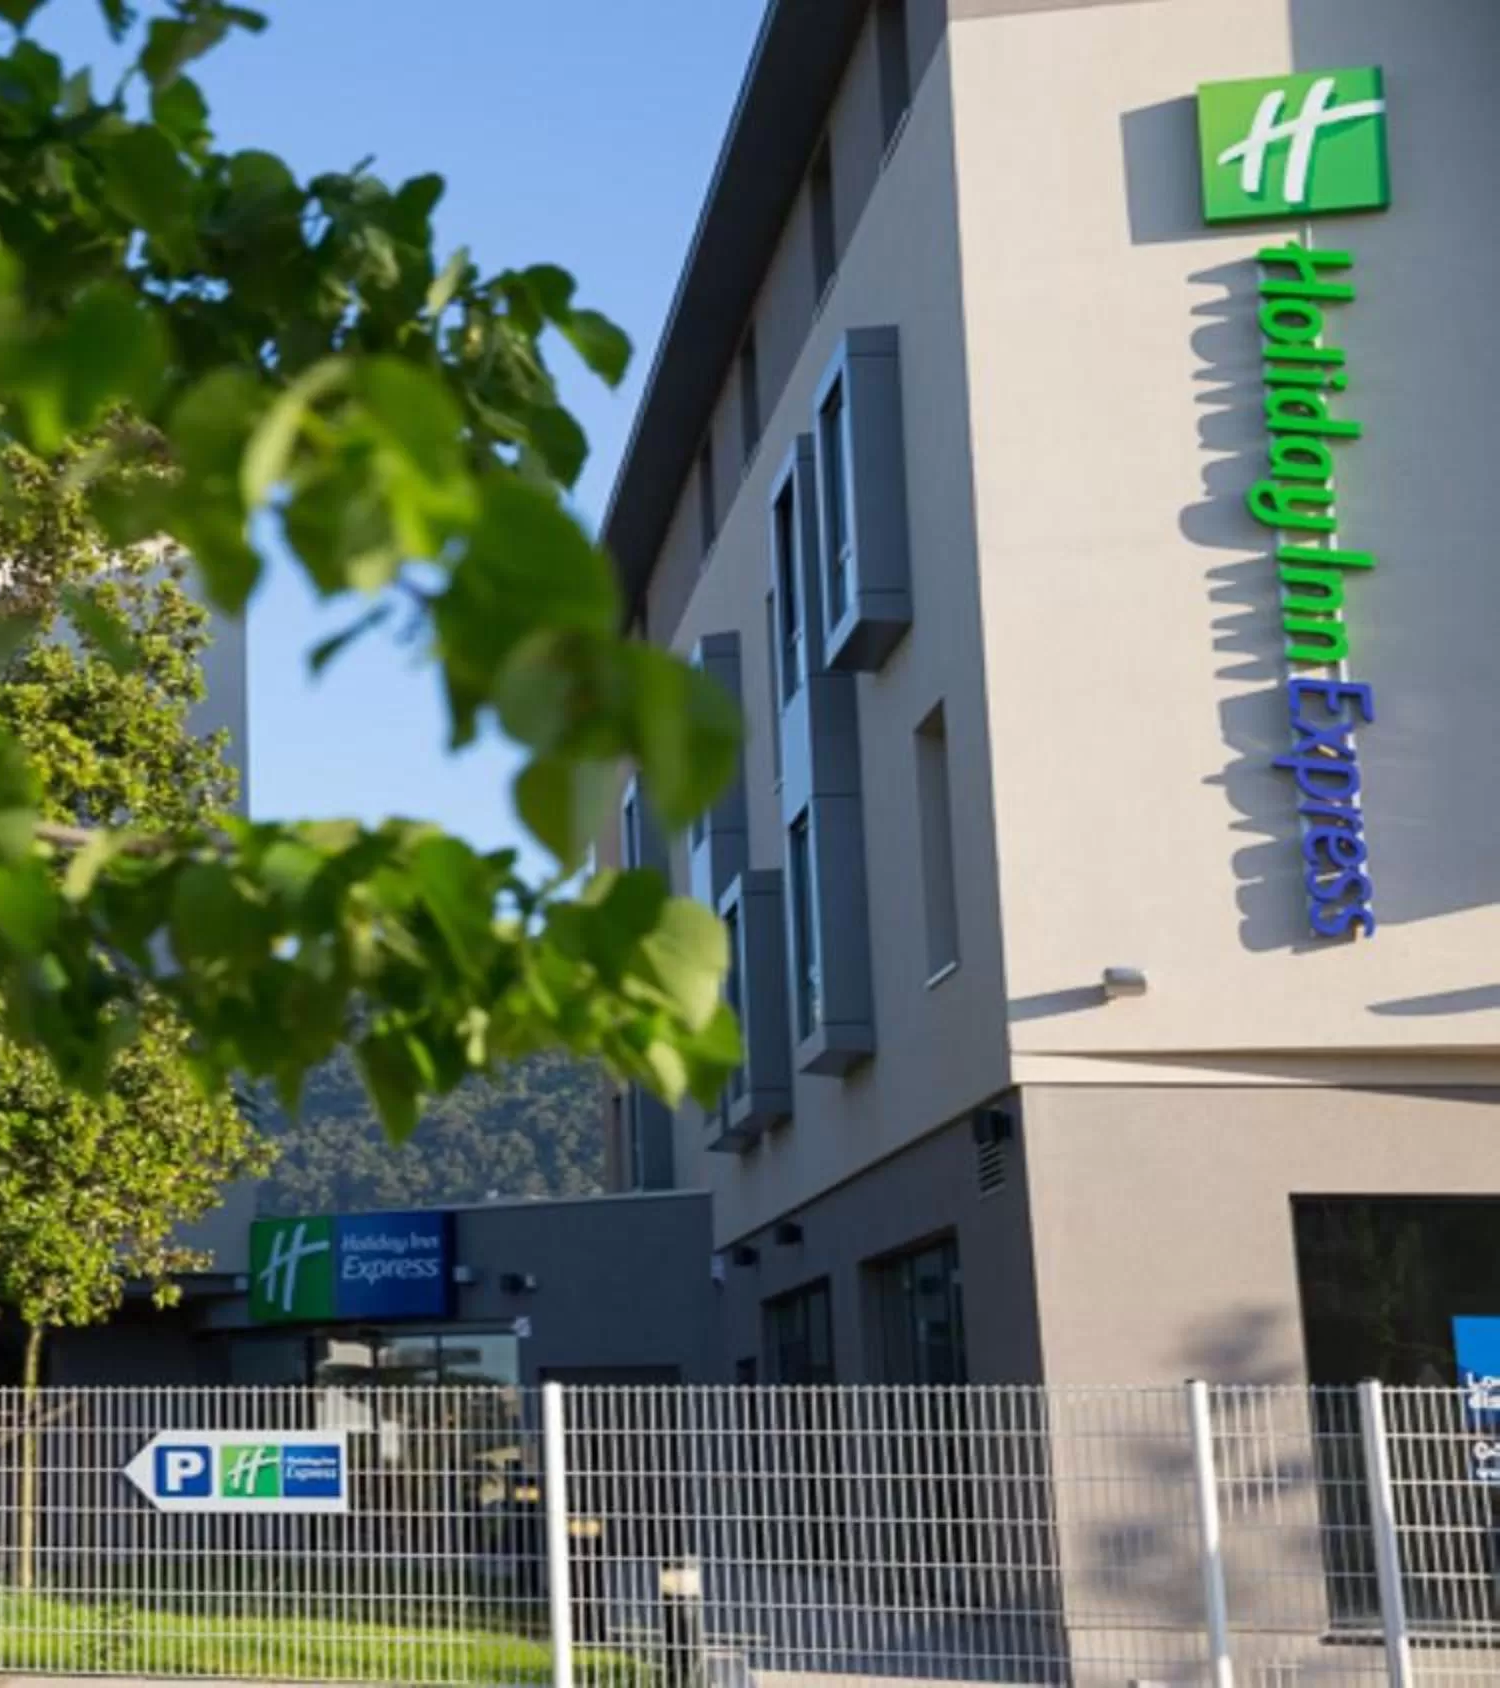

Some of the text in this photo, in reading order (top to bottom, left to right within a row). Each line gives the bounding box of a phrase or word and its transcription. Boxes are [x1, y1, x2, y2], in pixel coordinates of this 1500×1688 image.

[1247, 241, 1377, 662] Holiday Inn
[1271, 677, 1376, 939] Express
[340, 1230, 439, 1254] Holiday Inn
[341, 1254, 439, 1286] Express
[165, 1451, 205, 1492] P
